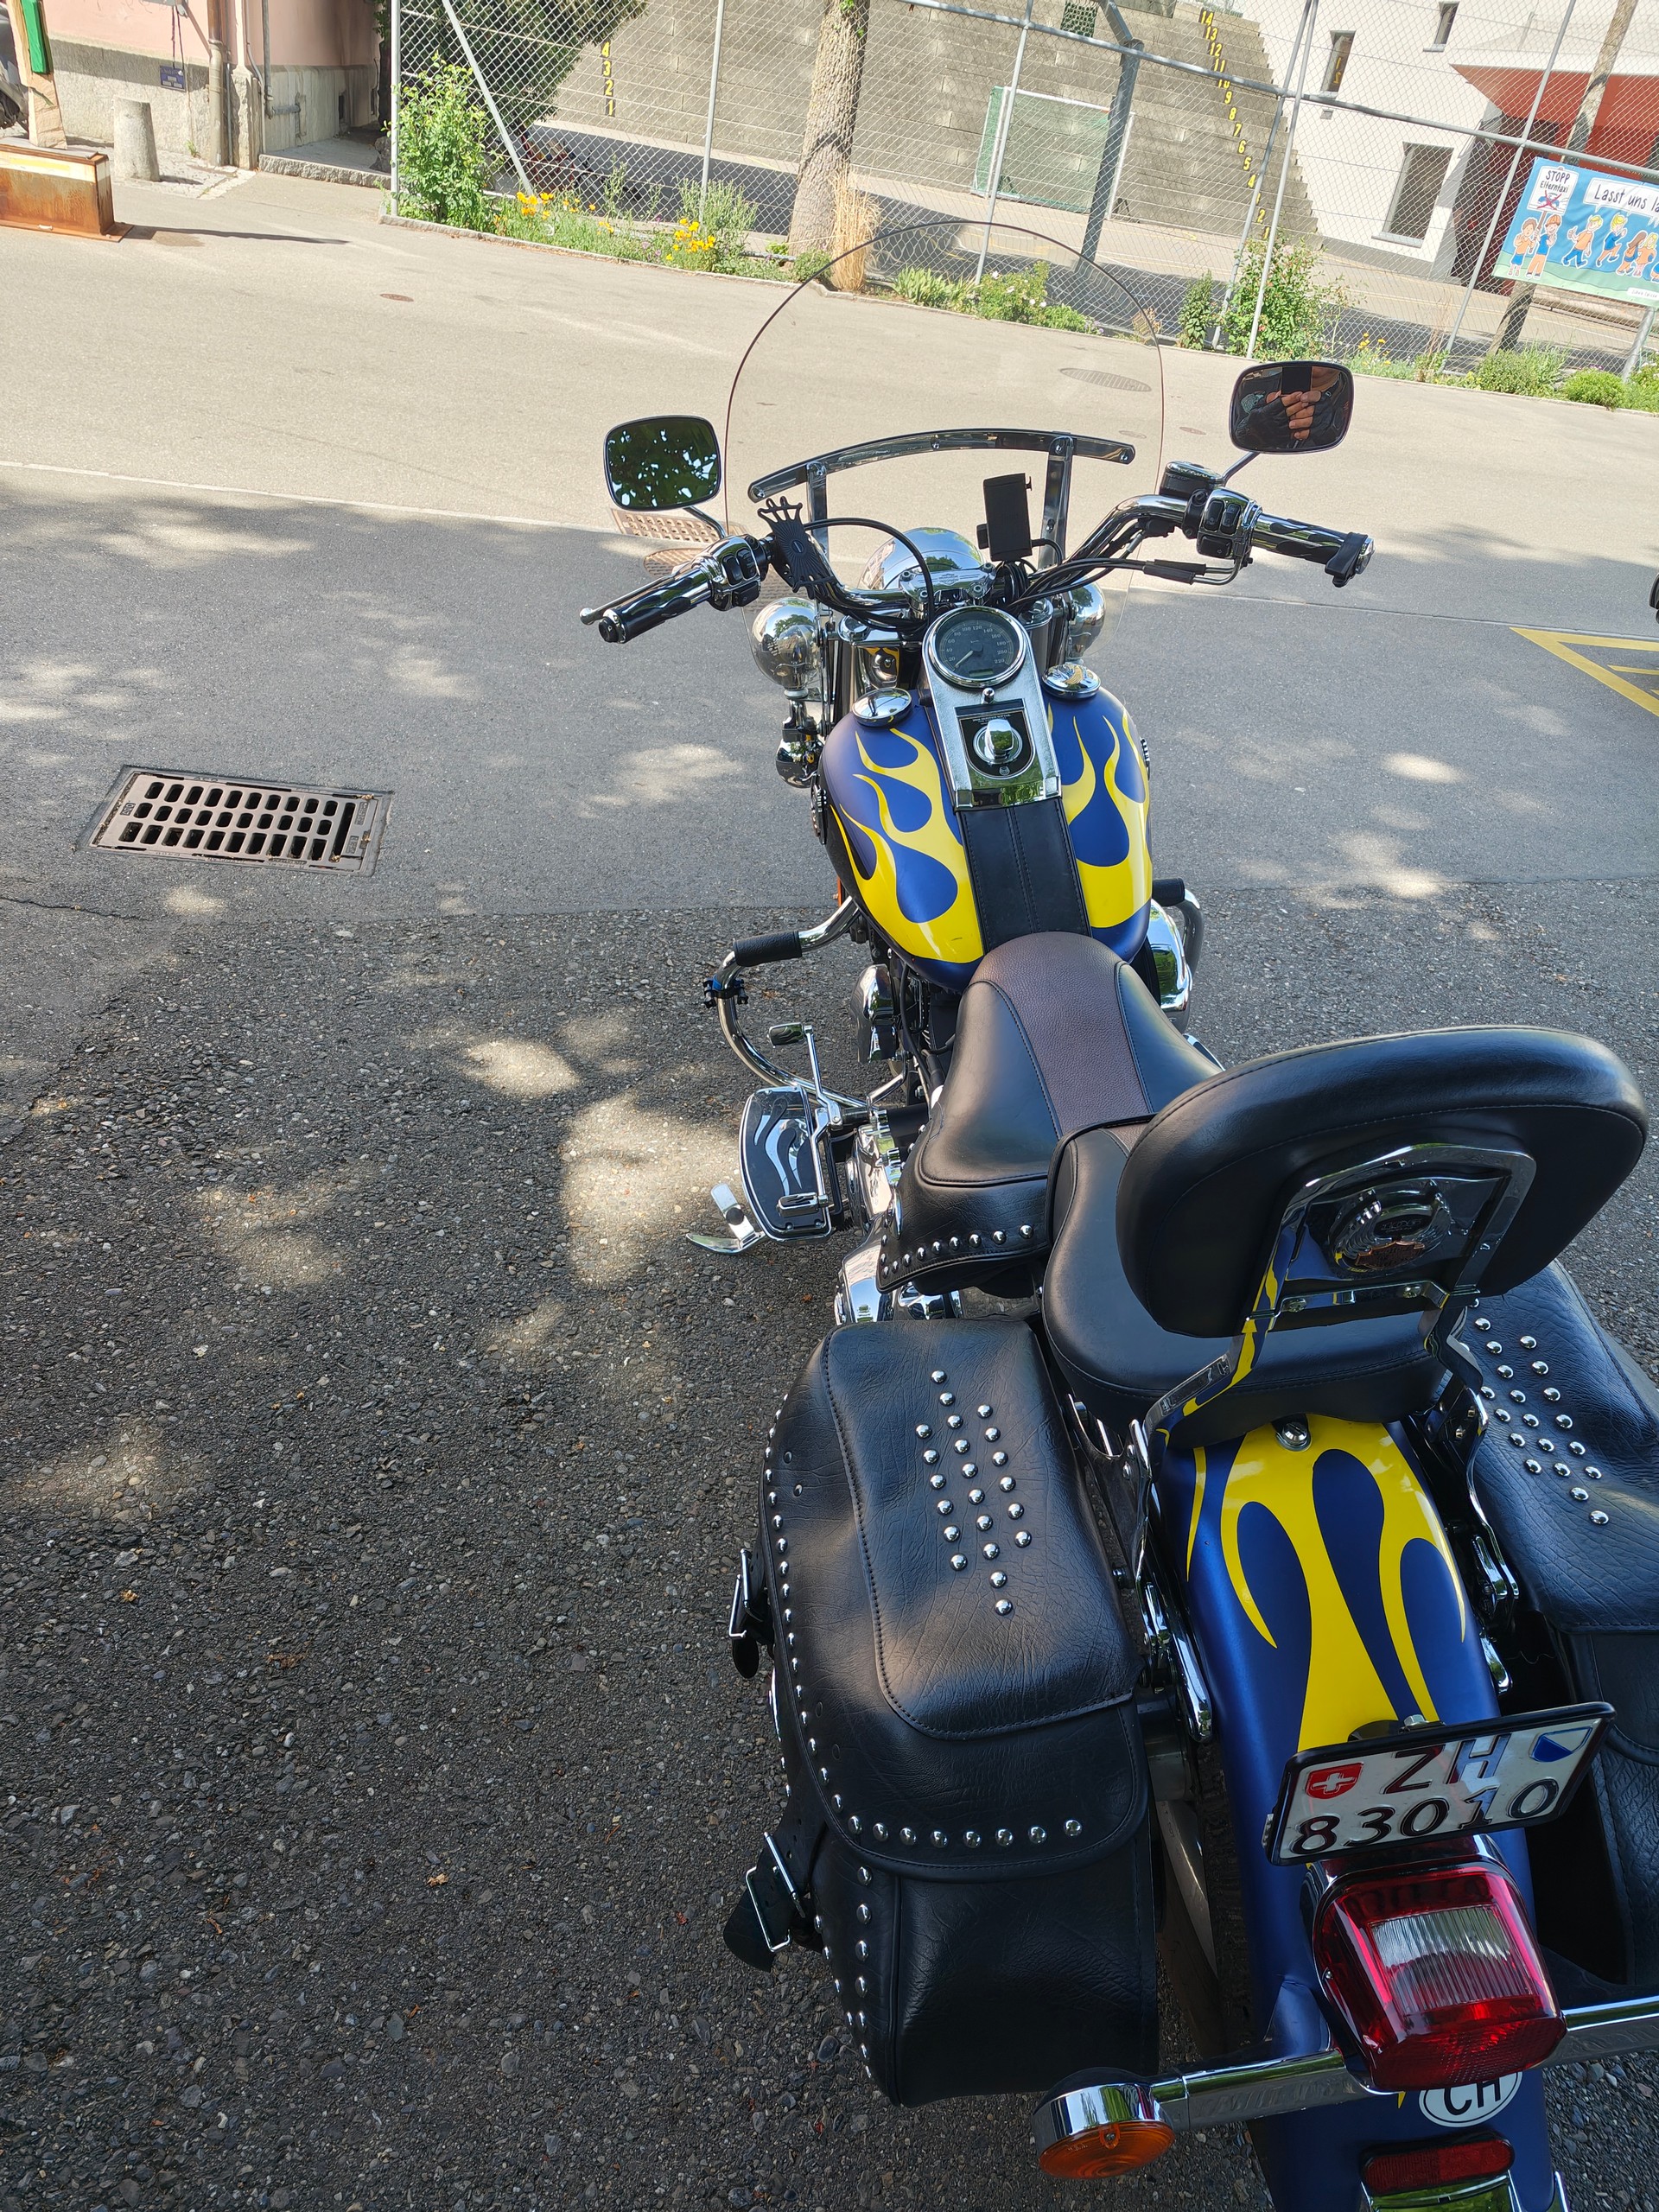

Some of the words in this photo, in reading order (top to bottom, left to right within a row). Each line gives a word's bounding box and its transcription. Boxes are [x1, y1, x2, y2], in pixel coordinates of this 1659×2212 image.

[1201, 10, 1214, 26] 14
[1205, 26, 1218, 41] 13
[601, 41, 610, 58] 4
[1210, 41, 1223, 57] 12
[603, 60, 611, 76] 3
[1214, 58, 1225, 73] 11
[605, 79, 613, 96] 2
[1224, 91, 1233, 104] 9
[608, 99, 613, 116] 1
[1229, 107, 1237, 121] 8
[1233, 123, 1243, 137] 7
[1238, 139, 1247, 154] 6
[1243, 156, 1252, 170] 5
[1248, 174, 1256, 188] 4
[1546, 170, 1570, 184] STOPP
[1540, 181, 1569, 193] Elterntaxi
[1594, 184, 1625, 204] Lasst
[1628, 195, 1648, 210] uns
[1257, 209, 1266, 223] 2
[1382, 1732, 1513, 1796] ZH
[1291, 1777, 1560, 1856] 83010
[1442, 2076, 1502, 2116] CH
